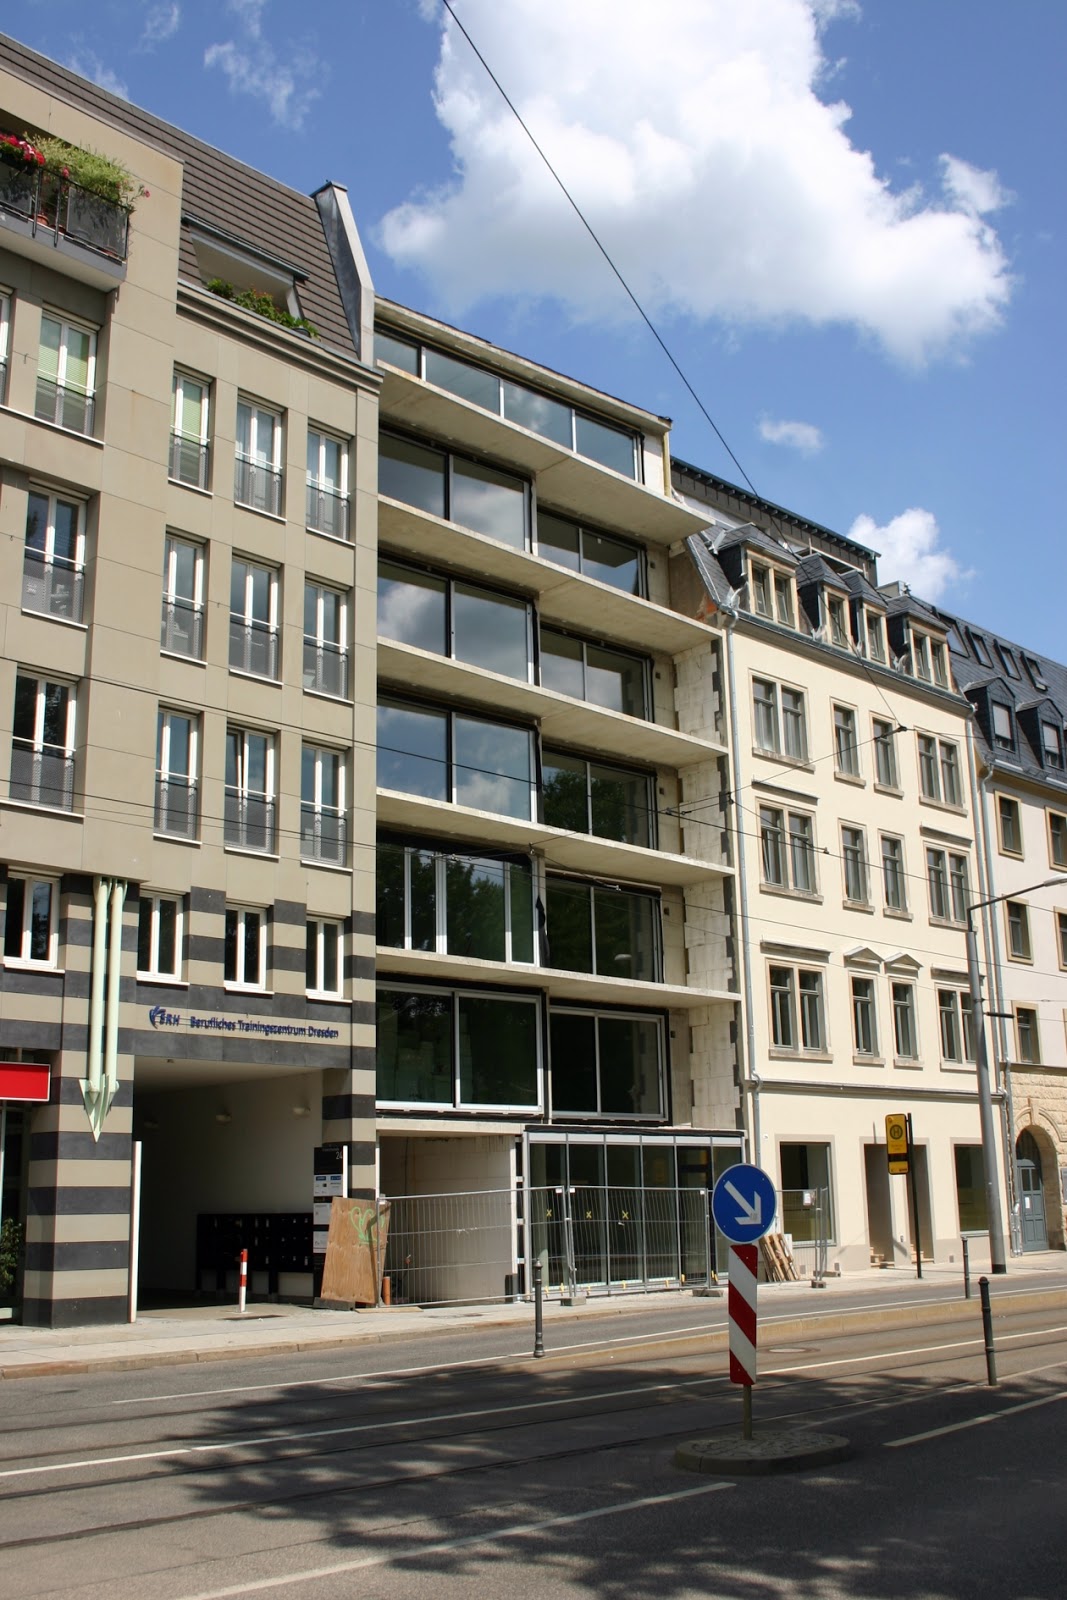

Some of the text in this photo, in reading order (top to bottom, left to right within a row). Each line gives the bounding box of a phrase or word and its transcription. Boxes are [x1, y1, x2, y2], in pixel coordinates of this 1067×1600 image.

[159, 1013, 339, 1039] SRH Berufliches Trainingszentrum Dresden
